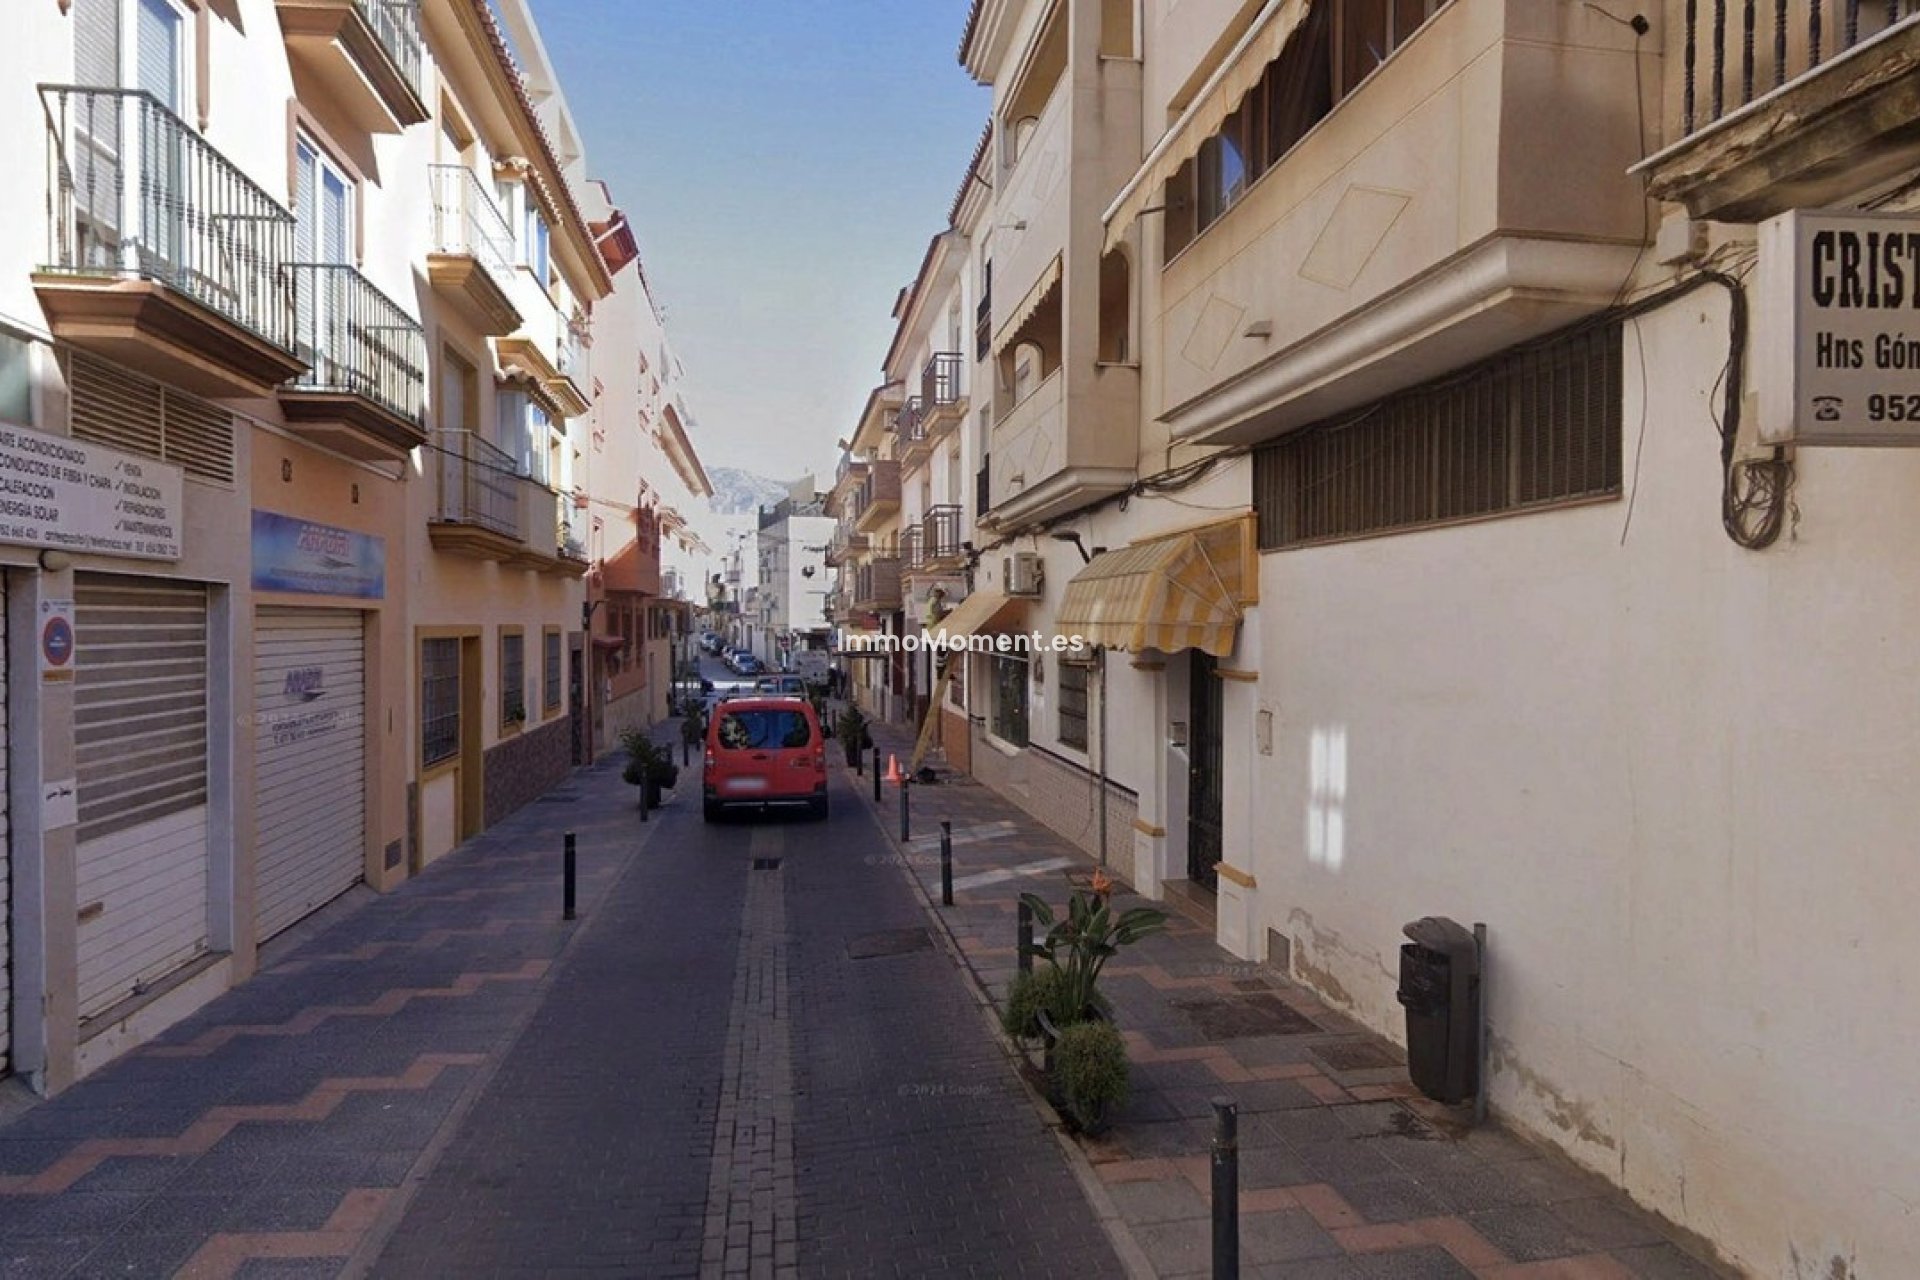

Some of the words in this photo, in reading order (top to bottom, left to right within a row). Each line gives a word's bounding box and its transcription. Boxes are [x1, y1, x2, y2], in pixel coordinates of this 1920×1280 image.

[1812, 231, 1920, 308] CRIST
[1816, 331, 1864, 369] Hns
[1868, 393, 1920, 421] 952
[0, 432, 15, 448] IRE
[17, 435, 86, 465] ACONDICIONADO
[51, 464, 61, 480] DE
